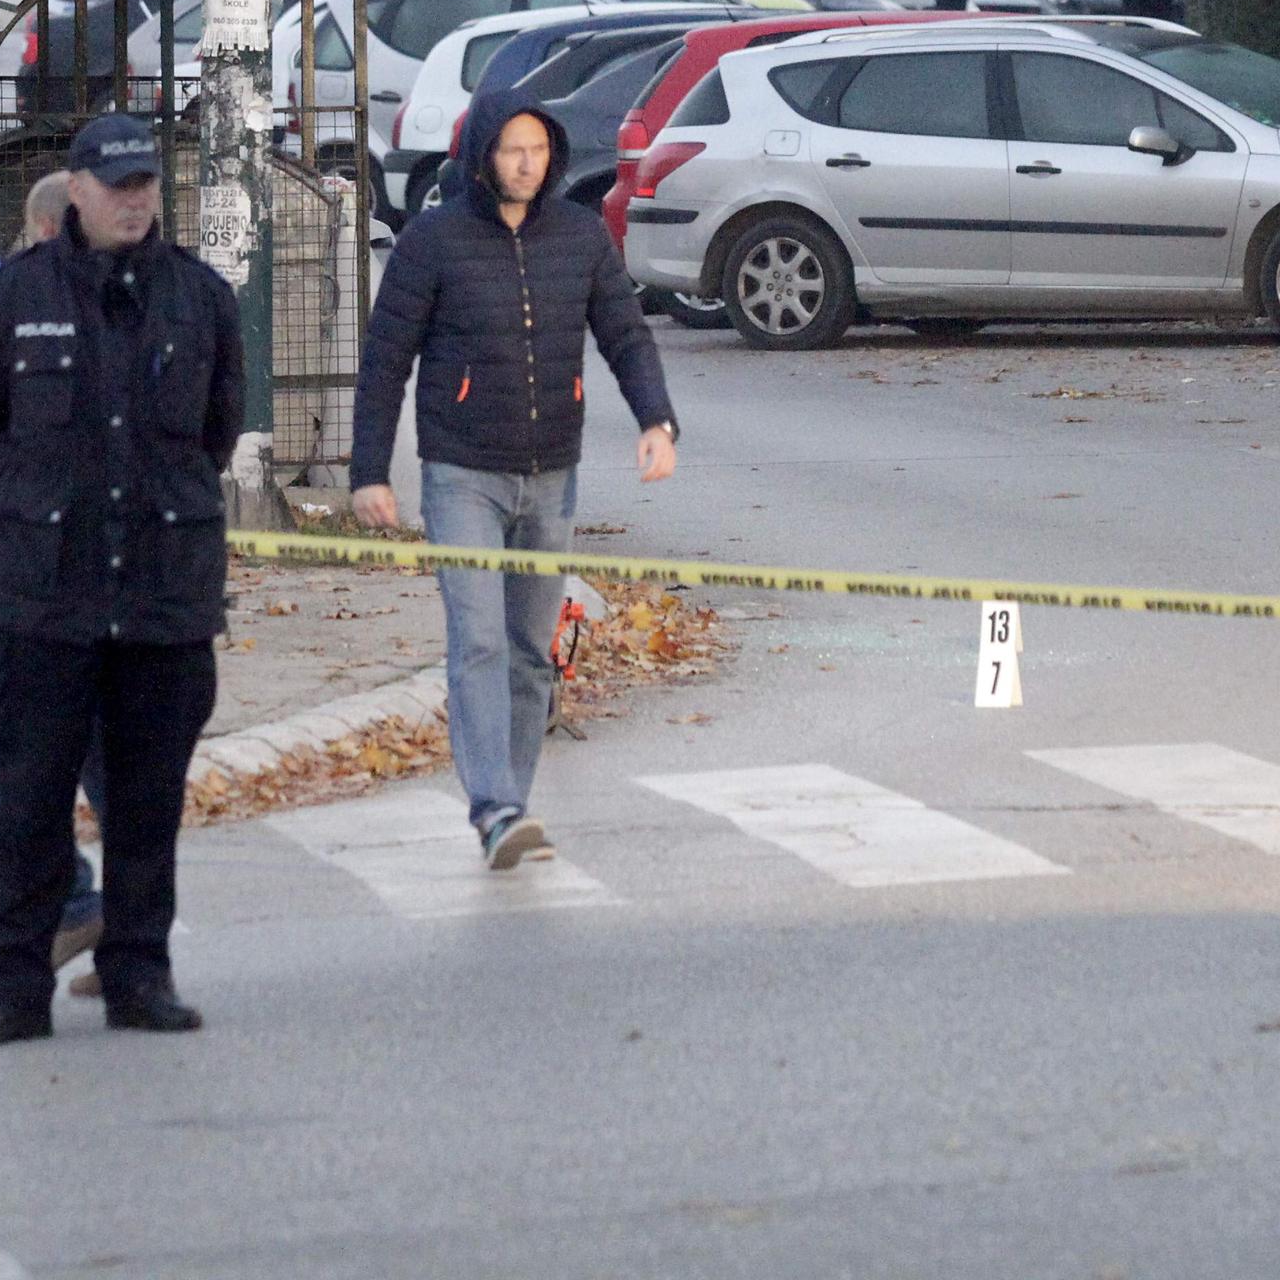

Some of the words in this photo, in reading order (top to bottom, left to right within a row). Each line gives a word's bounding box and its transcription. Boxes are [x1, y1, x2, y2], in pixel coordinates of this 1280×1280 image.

[223, 0, 249, 7] ŠKOLE
[988, 610, 1010, 643] 13
[991, 661, 1002, 695] 7
